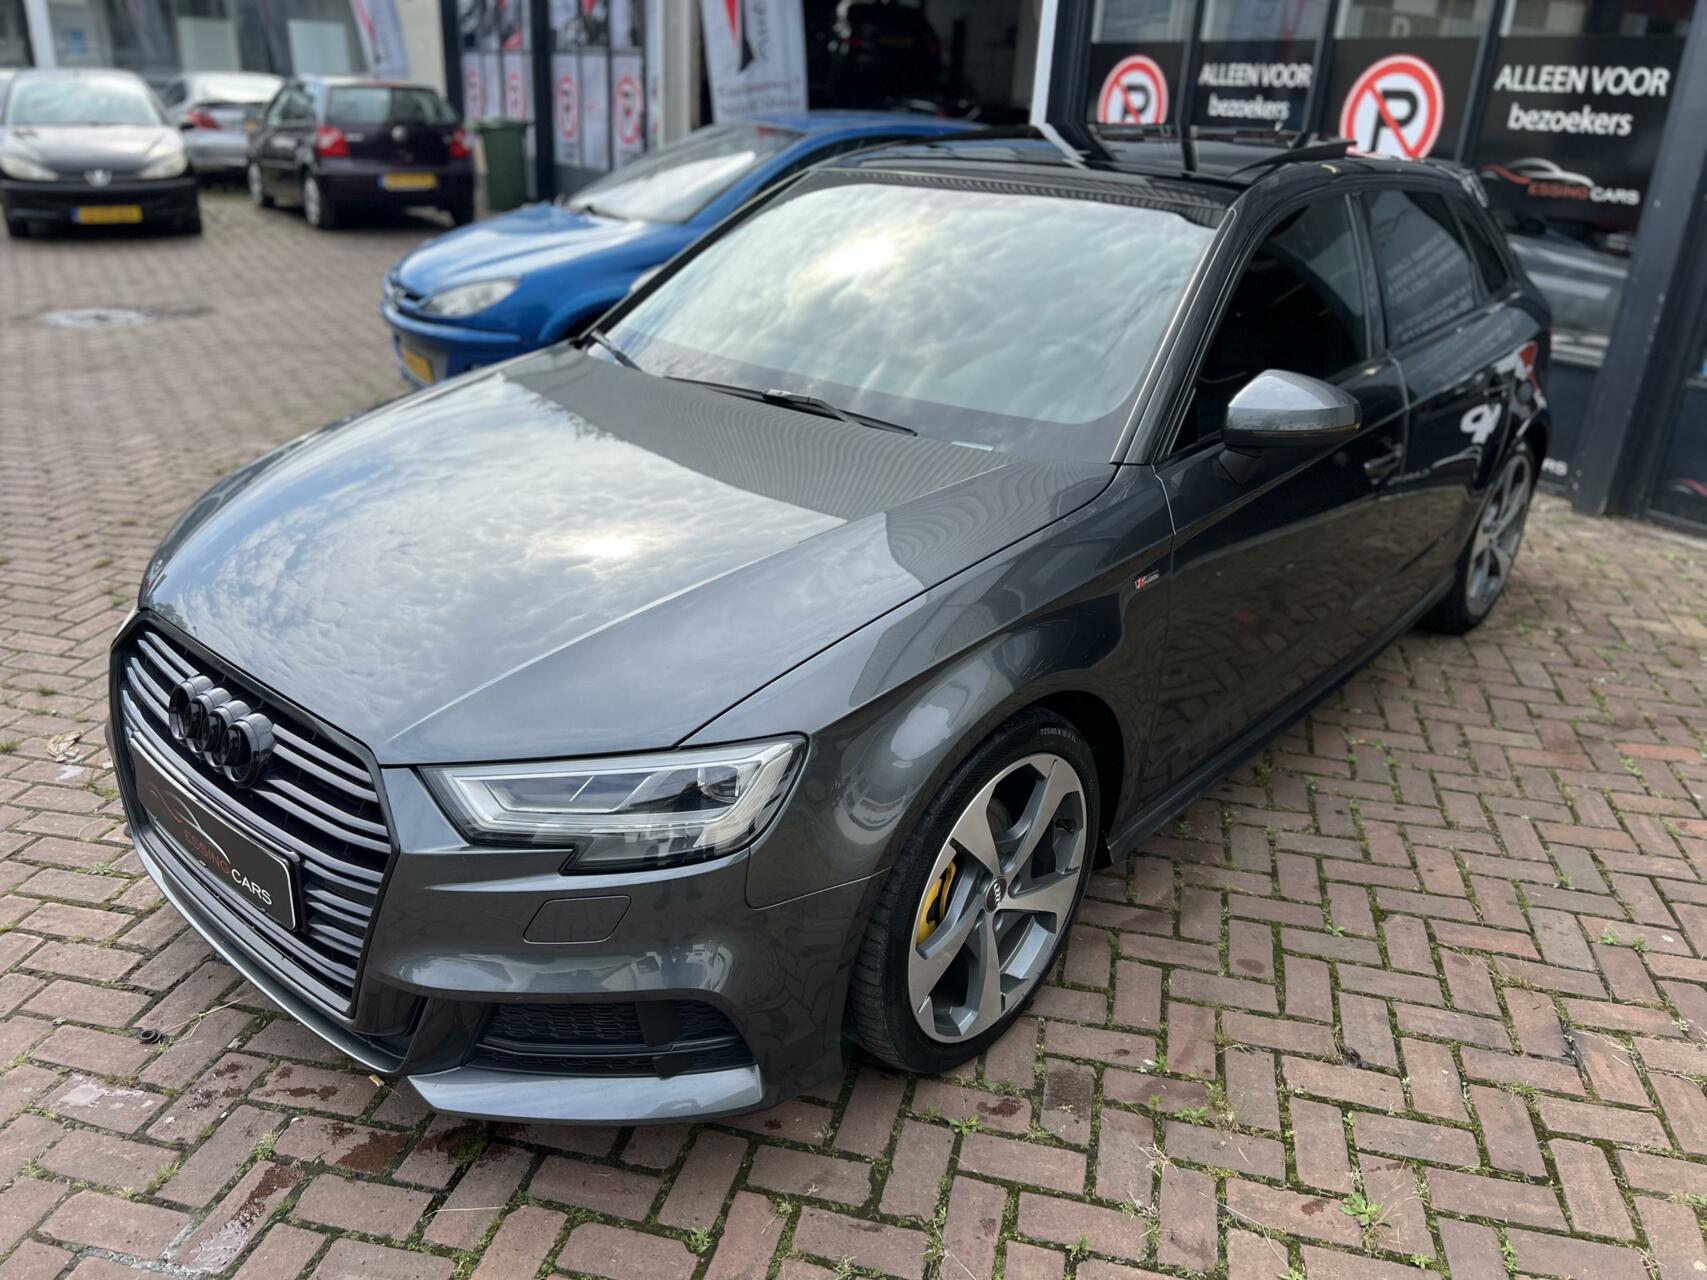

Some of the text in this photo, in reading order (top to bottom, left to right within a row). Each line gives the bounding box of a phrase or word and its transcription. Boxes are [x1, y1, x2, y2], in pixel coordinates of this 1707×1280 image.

[1198, 62, 1313, 88] ALLEEN VOOR
[1493, 64, 1670, 97] ALLEEN VOOR
[1207, 93, 1290, 120] bezoekers
[1507, 101, 1634, 136] bezoekers
[231, 868, 272, 905] CARS
